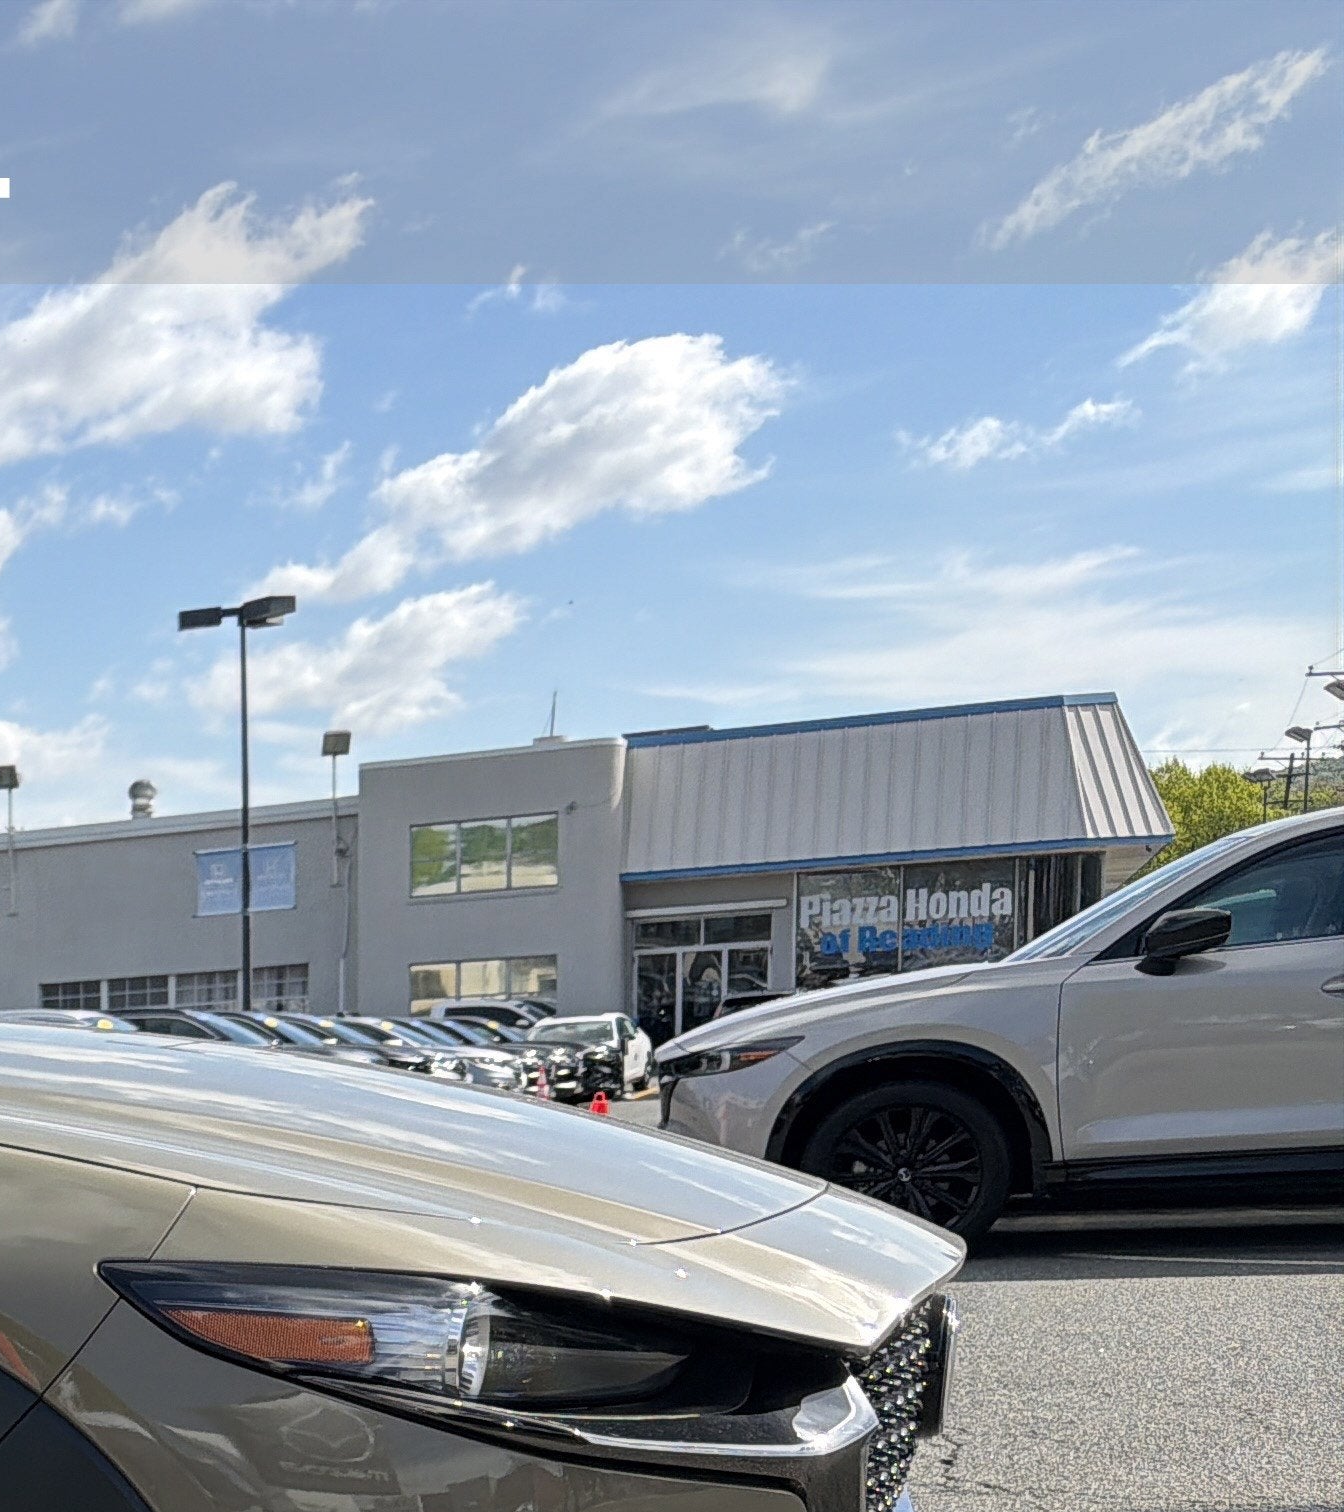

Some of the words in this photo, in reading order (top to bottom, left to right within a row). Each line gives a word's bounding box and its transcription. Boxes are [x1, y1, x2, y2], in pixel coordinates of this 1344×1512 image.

[799, 892, 899, 929] Piazza
[905, 882, 1013, 921] Honda
[820, 928, 851, 956] of
[858, 922, 994, 953] Reading
